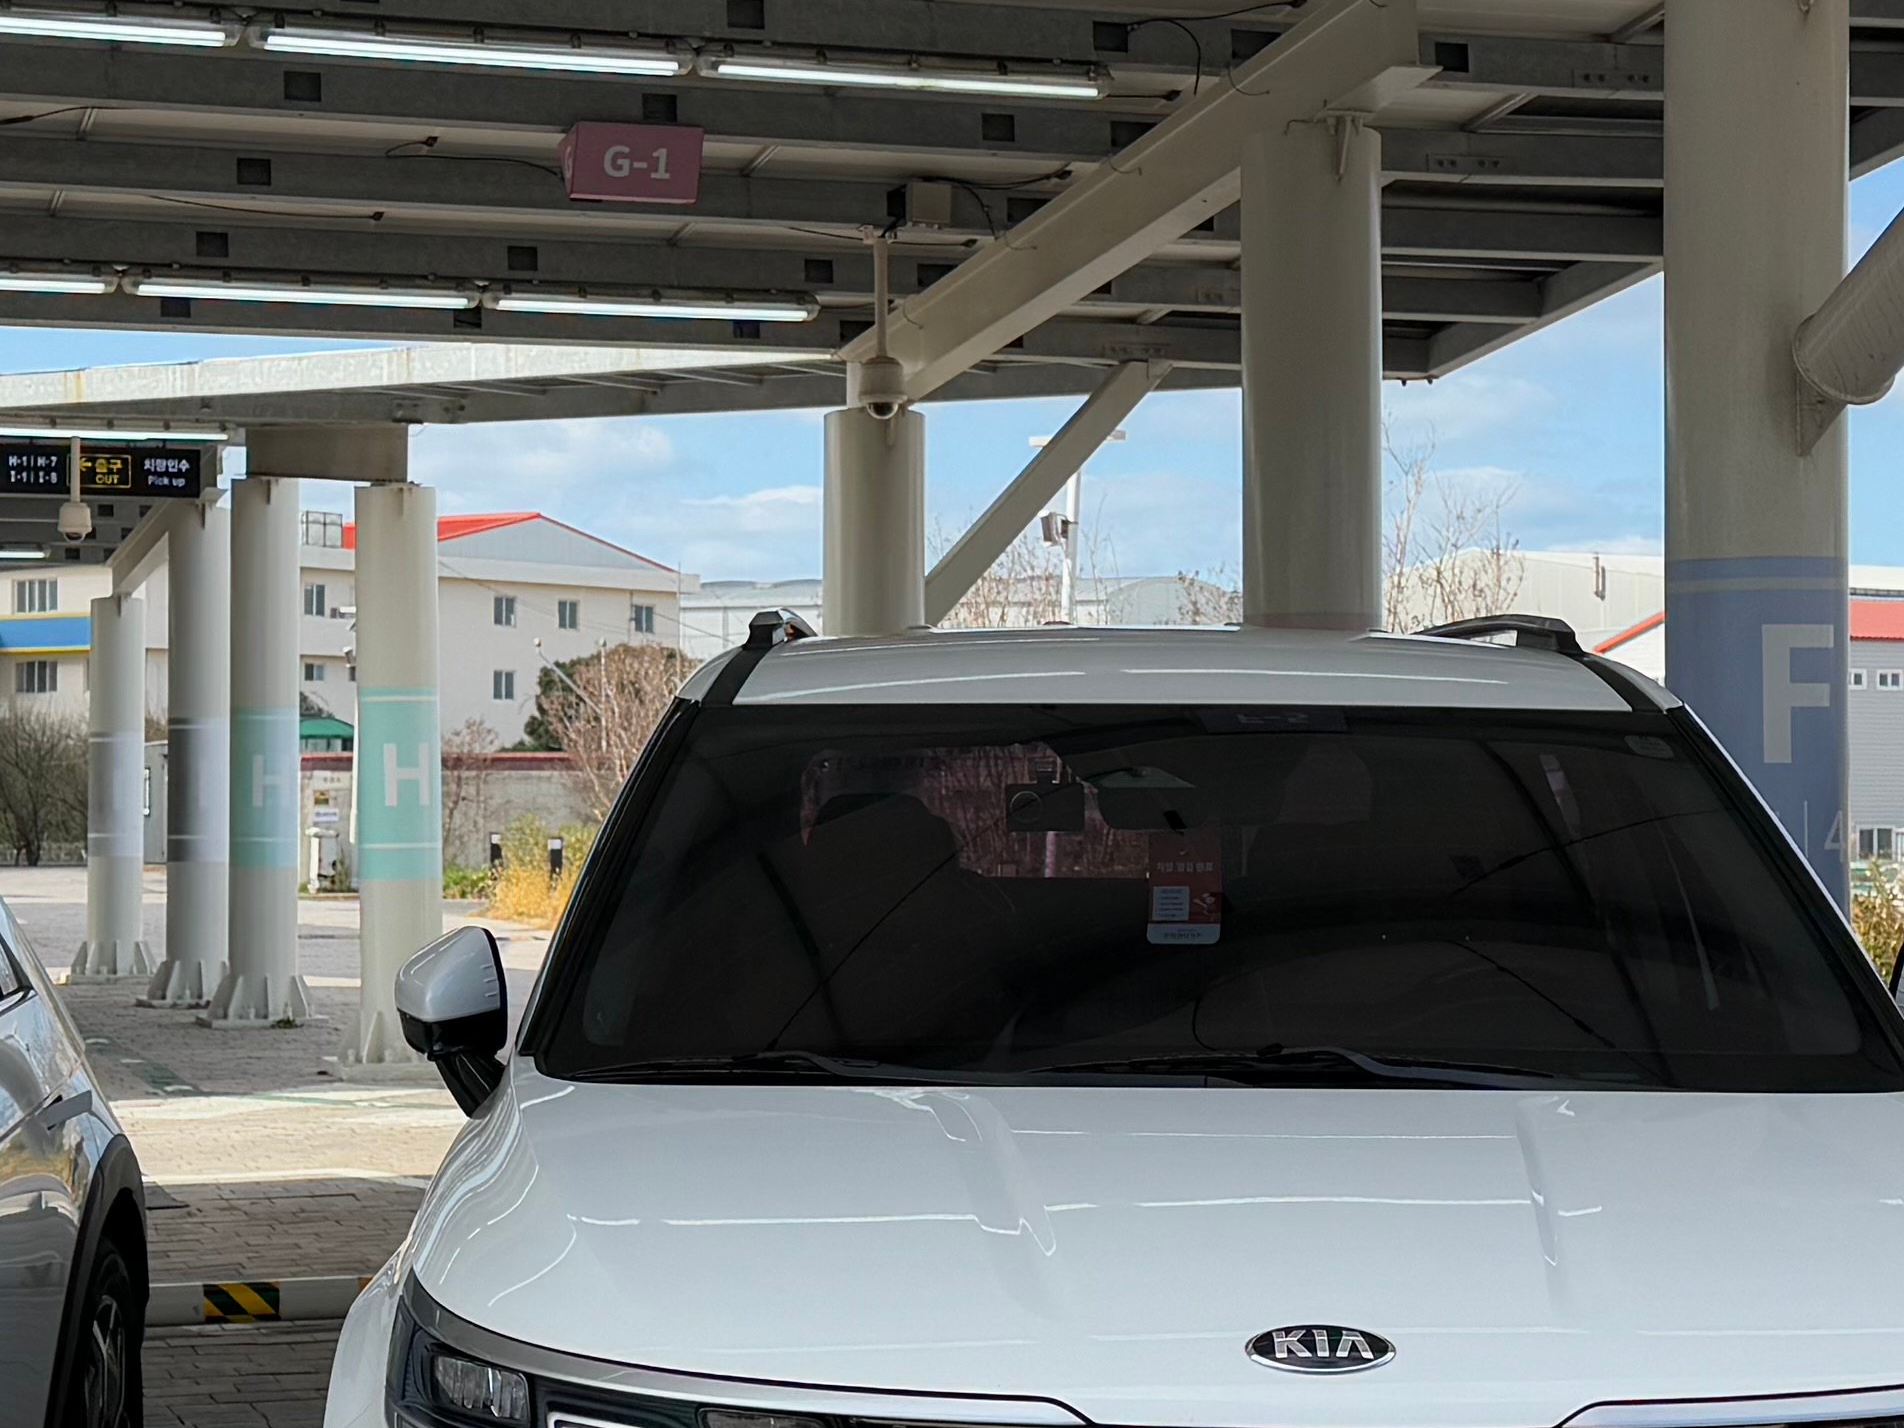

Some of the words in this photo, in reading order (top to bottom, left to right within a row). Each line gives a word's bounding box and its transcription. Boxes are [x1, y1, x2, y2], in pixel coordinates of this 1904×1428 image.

[603, 145, 671, 180] G-1
[95, 474, 121, 484] OUT
[148, 475, 169, 486] Pick
[172, 477, 186, 488] up
[1761, 624, 1834, 764] F
[383, 742, 431, 807] H
[1271, 1329, 1375, 1359] KIA
